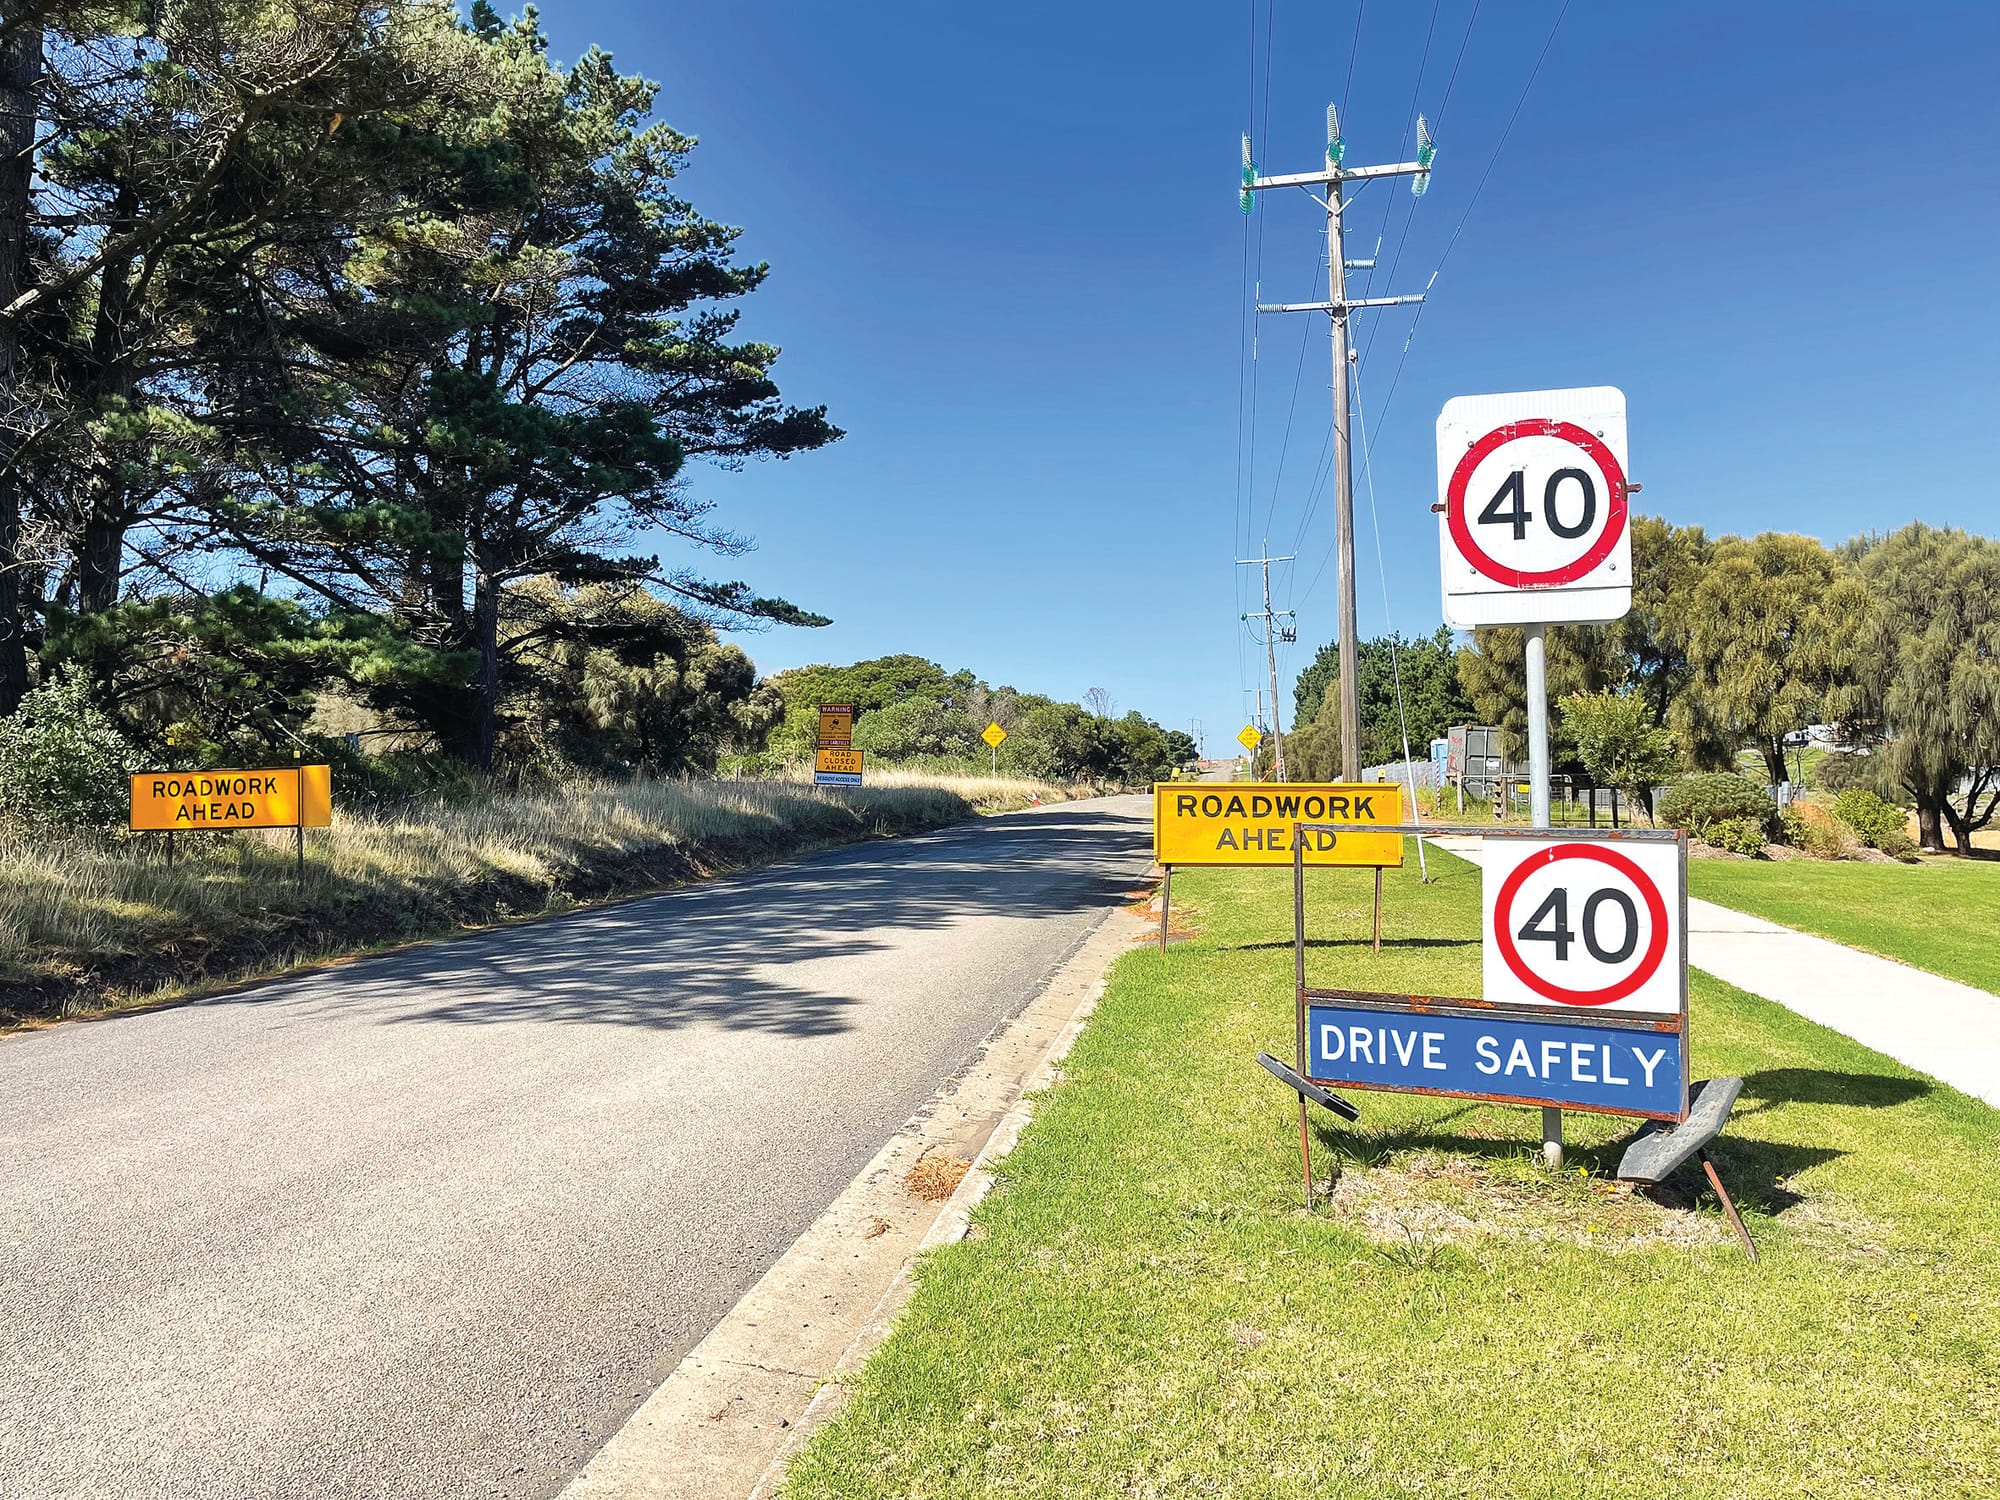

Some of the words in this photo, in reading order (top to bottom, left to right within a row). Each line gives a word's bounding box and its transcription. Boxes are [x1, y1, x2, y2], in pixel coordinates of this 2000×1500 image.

[1477, 468, 1596, 540] 40
[152, 777, 278, 798] ROADWORK
[1177, 795, 1375, 819] ROADWORK
[175, 802, 255, 821] AHEAD
[1517, 887, 1638, 965] 40
[1320, 1024, 1447, 1070] DRIVE
[1475, 1036, 1667, 1088] SAFELY
